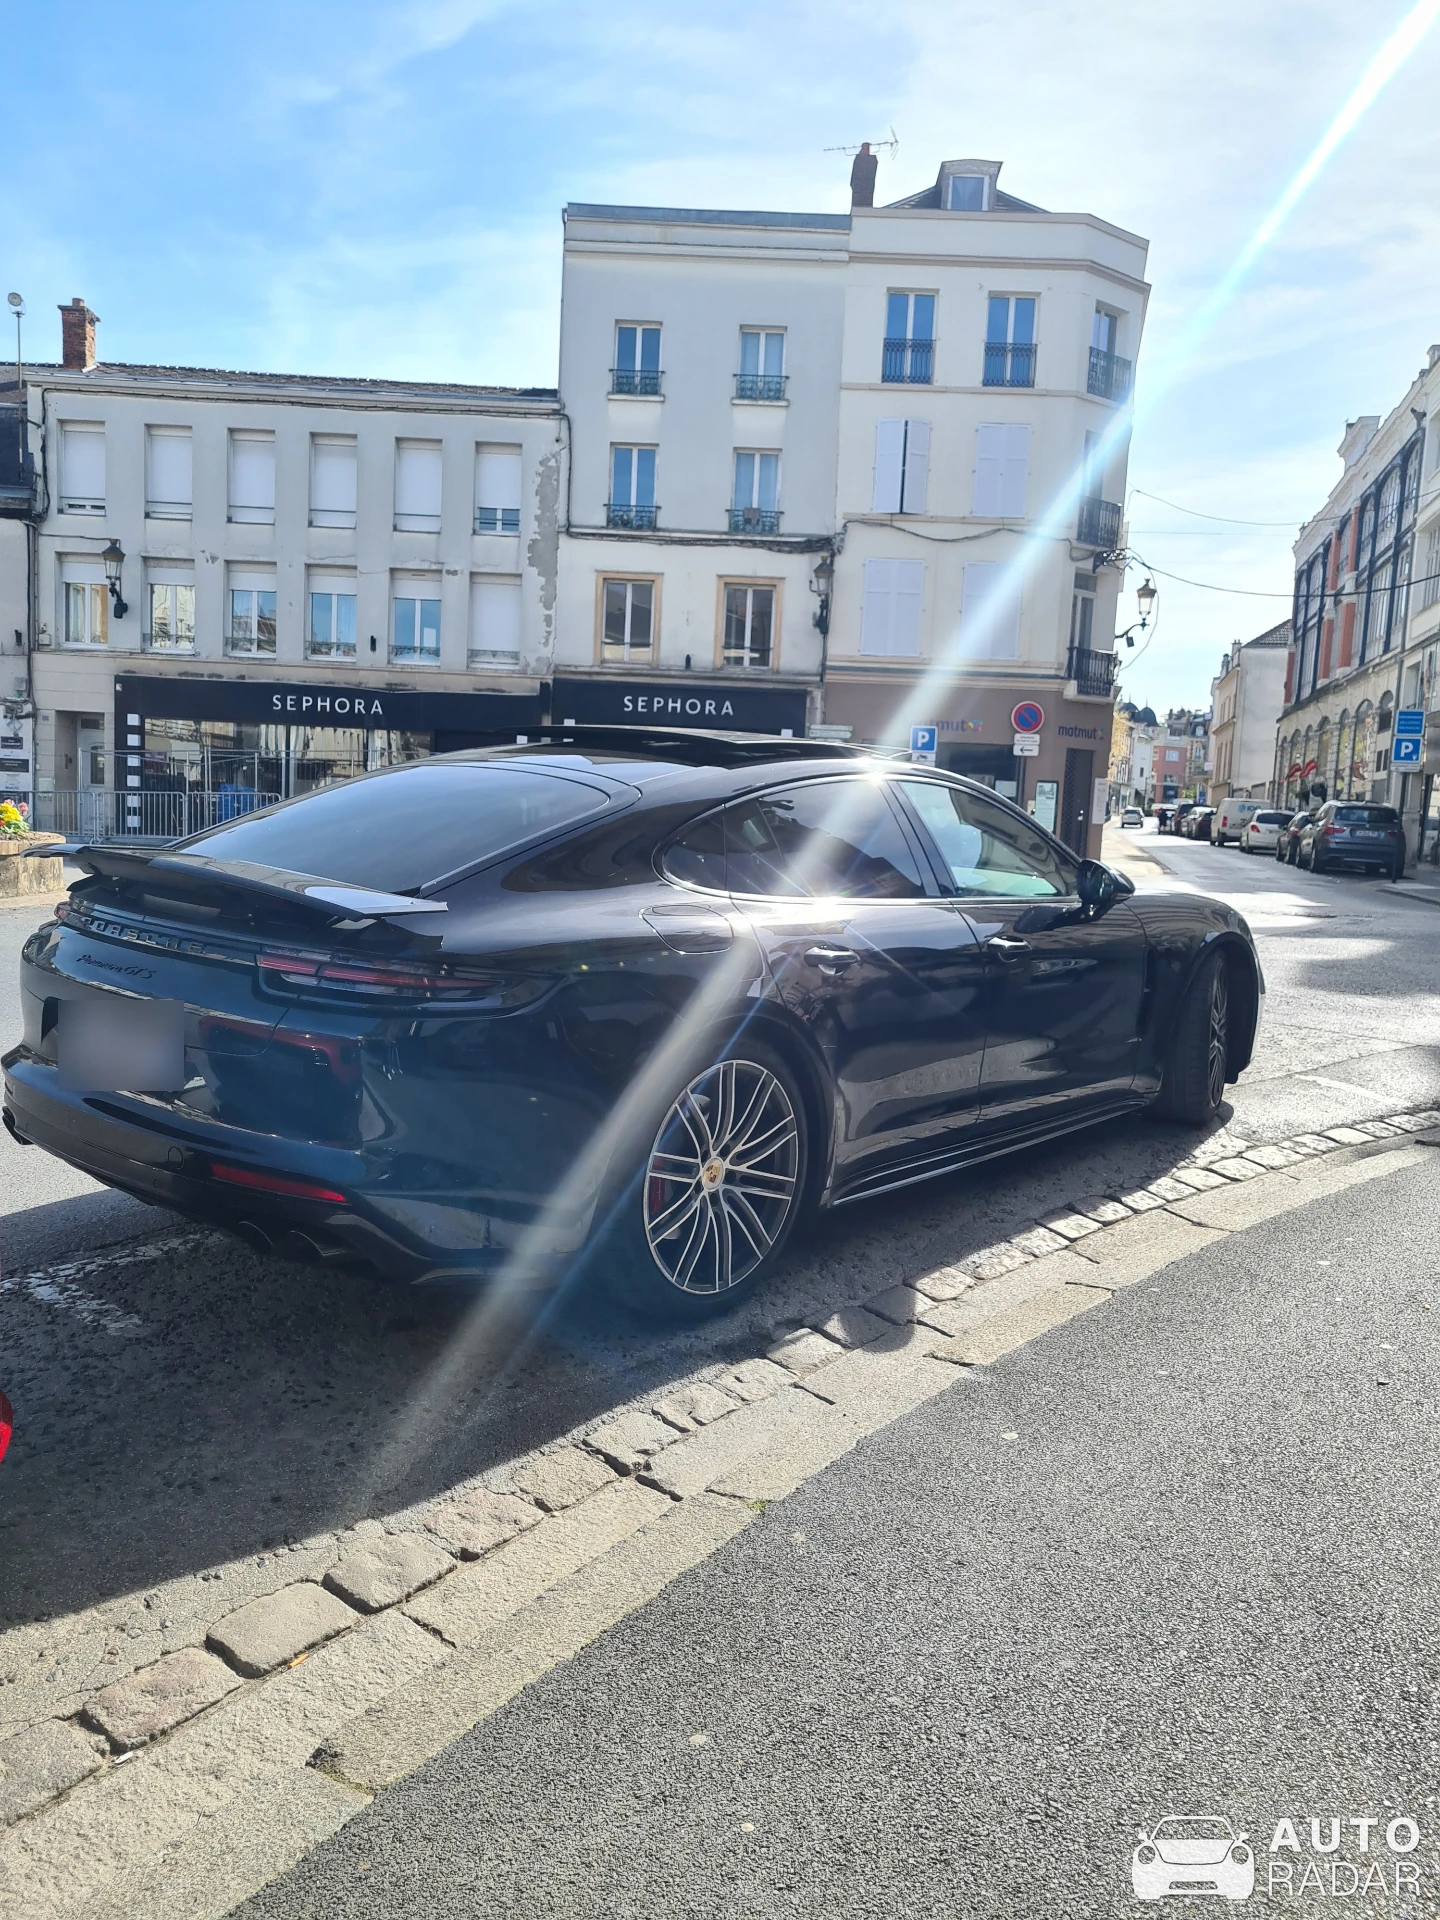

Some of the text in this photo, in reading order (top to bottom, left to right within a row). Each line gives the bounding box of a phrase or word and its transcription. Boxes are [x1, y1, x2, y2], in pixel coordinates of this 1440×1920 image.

[272, 694, 383, 715] SEPHORA
[623, 695, 734, 716] SEPHORA
[917, 731, 930, 748] P
[1057, 724, 1098, 740] matmut
[1400, 741, 1414, 758] P
[81, 916, 204, 954] PORSCHE
